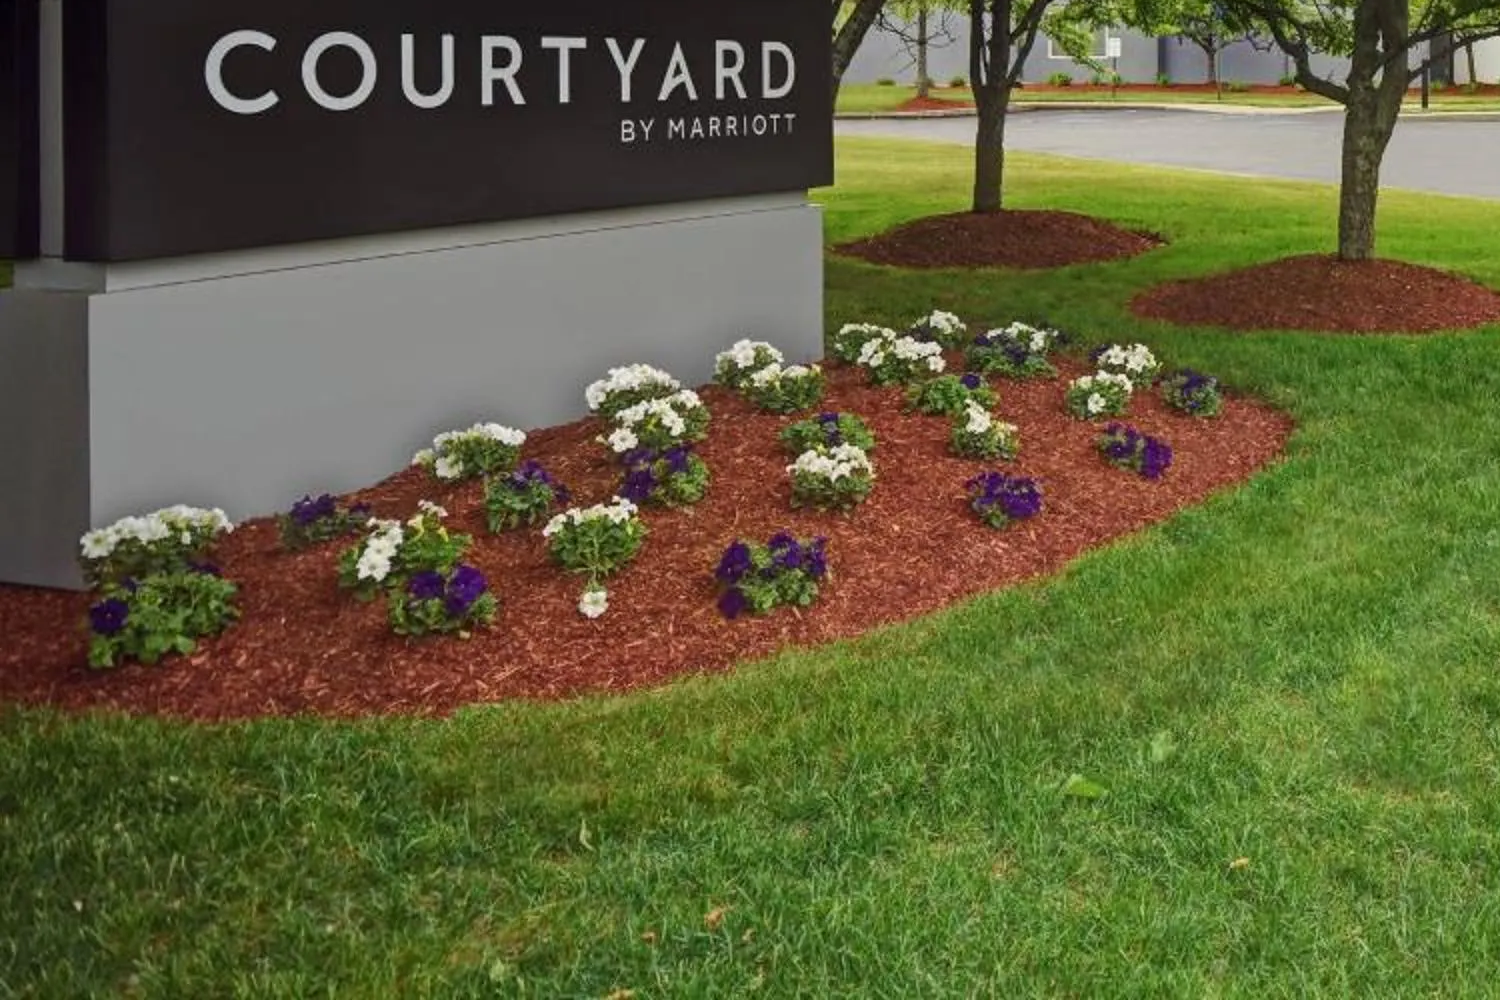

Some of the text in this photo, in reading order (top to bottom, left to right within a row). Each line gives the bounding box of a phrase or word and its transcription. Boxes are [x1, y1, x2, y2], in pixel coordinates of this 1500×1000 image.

[204, 29, 797, 115] COURTYARD
[620, 112, 797, 143] BY MARRIOTT
